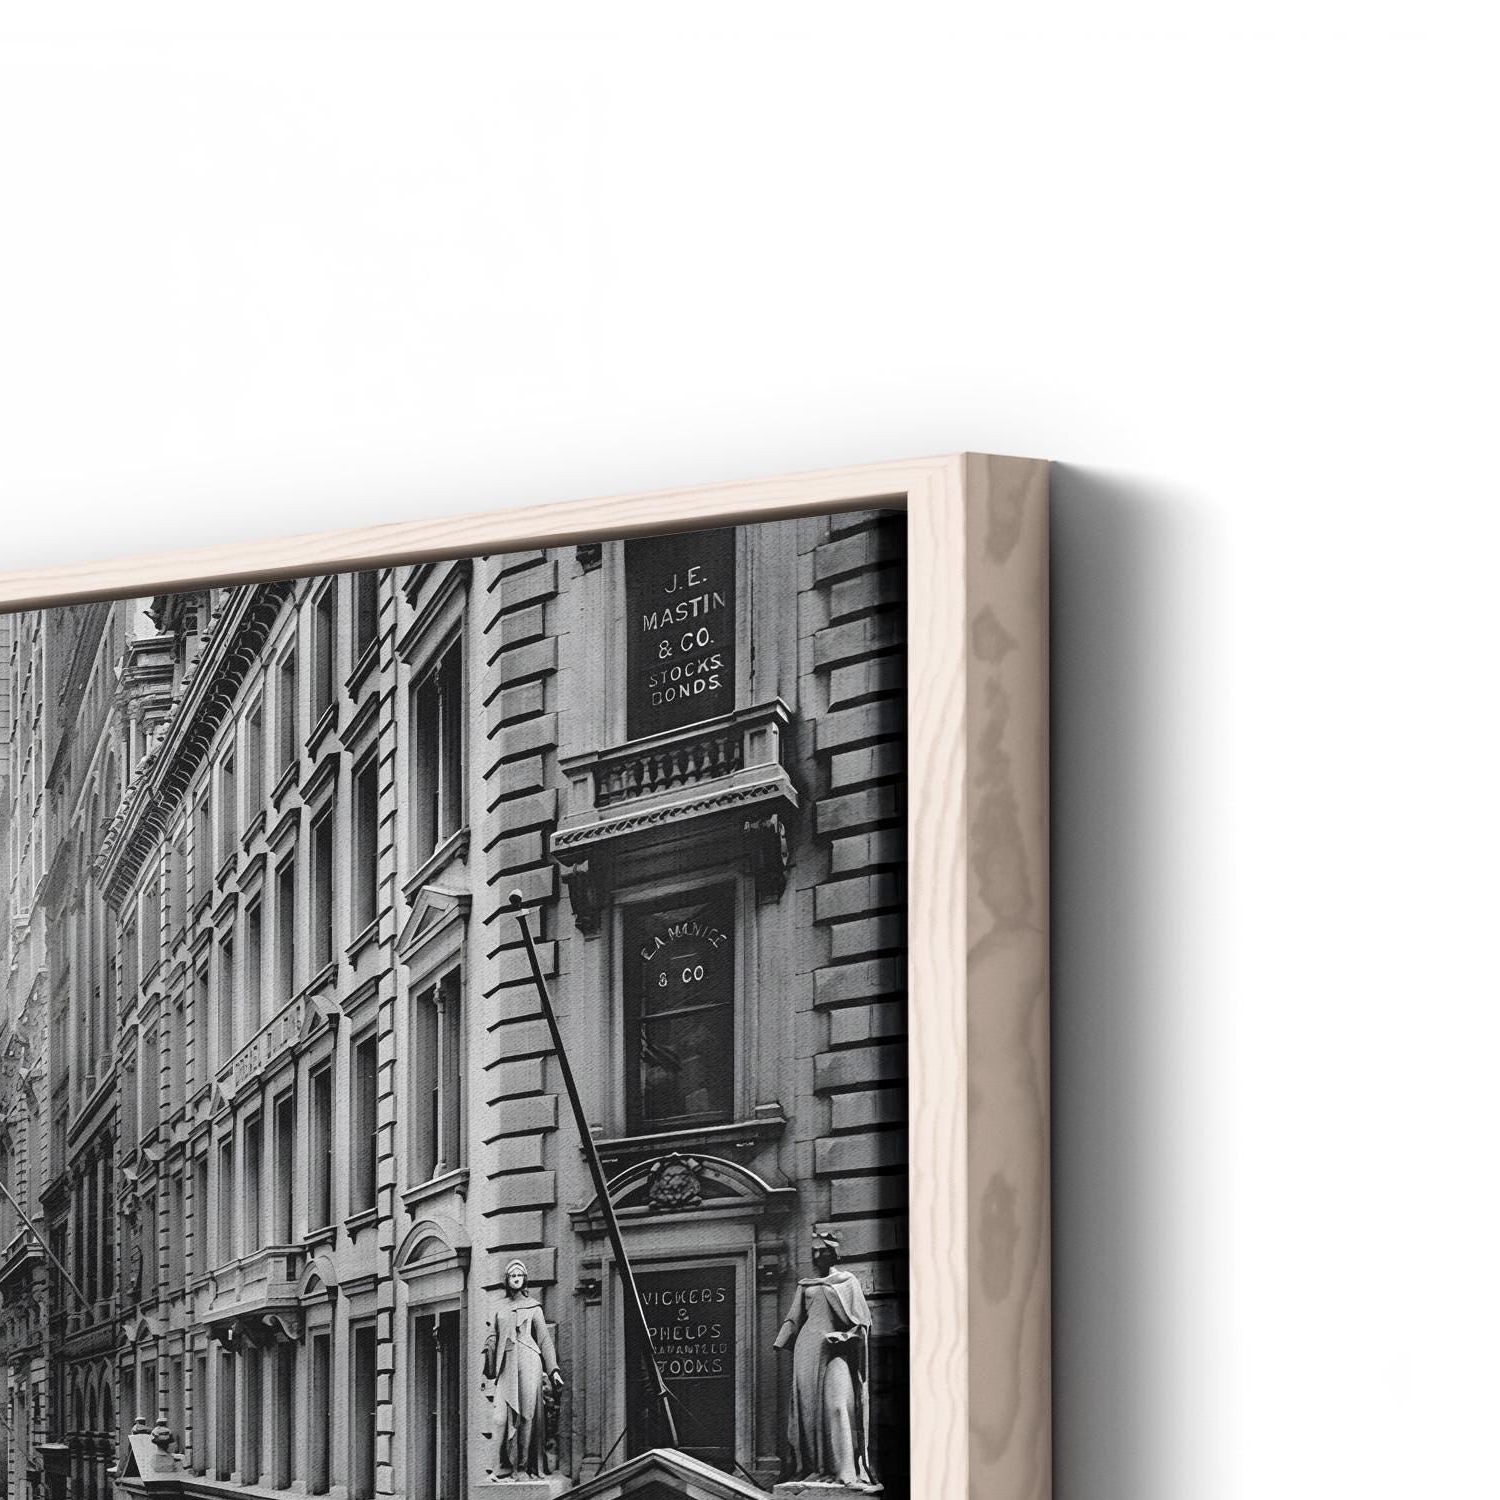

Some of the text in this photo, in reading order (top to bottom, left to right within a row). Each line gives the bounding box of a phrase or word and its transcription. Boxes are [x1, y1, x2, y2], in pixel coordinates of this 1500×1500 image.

[642, 591, 726, 632] MASTIN
[658, 627, 715, 660] & CO.
[648, 654, 725, 688] STOCKS
